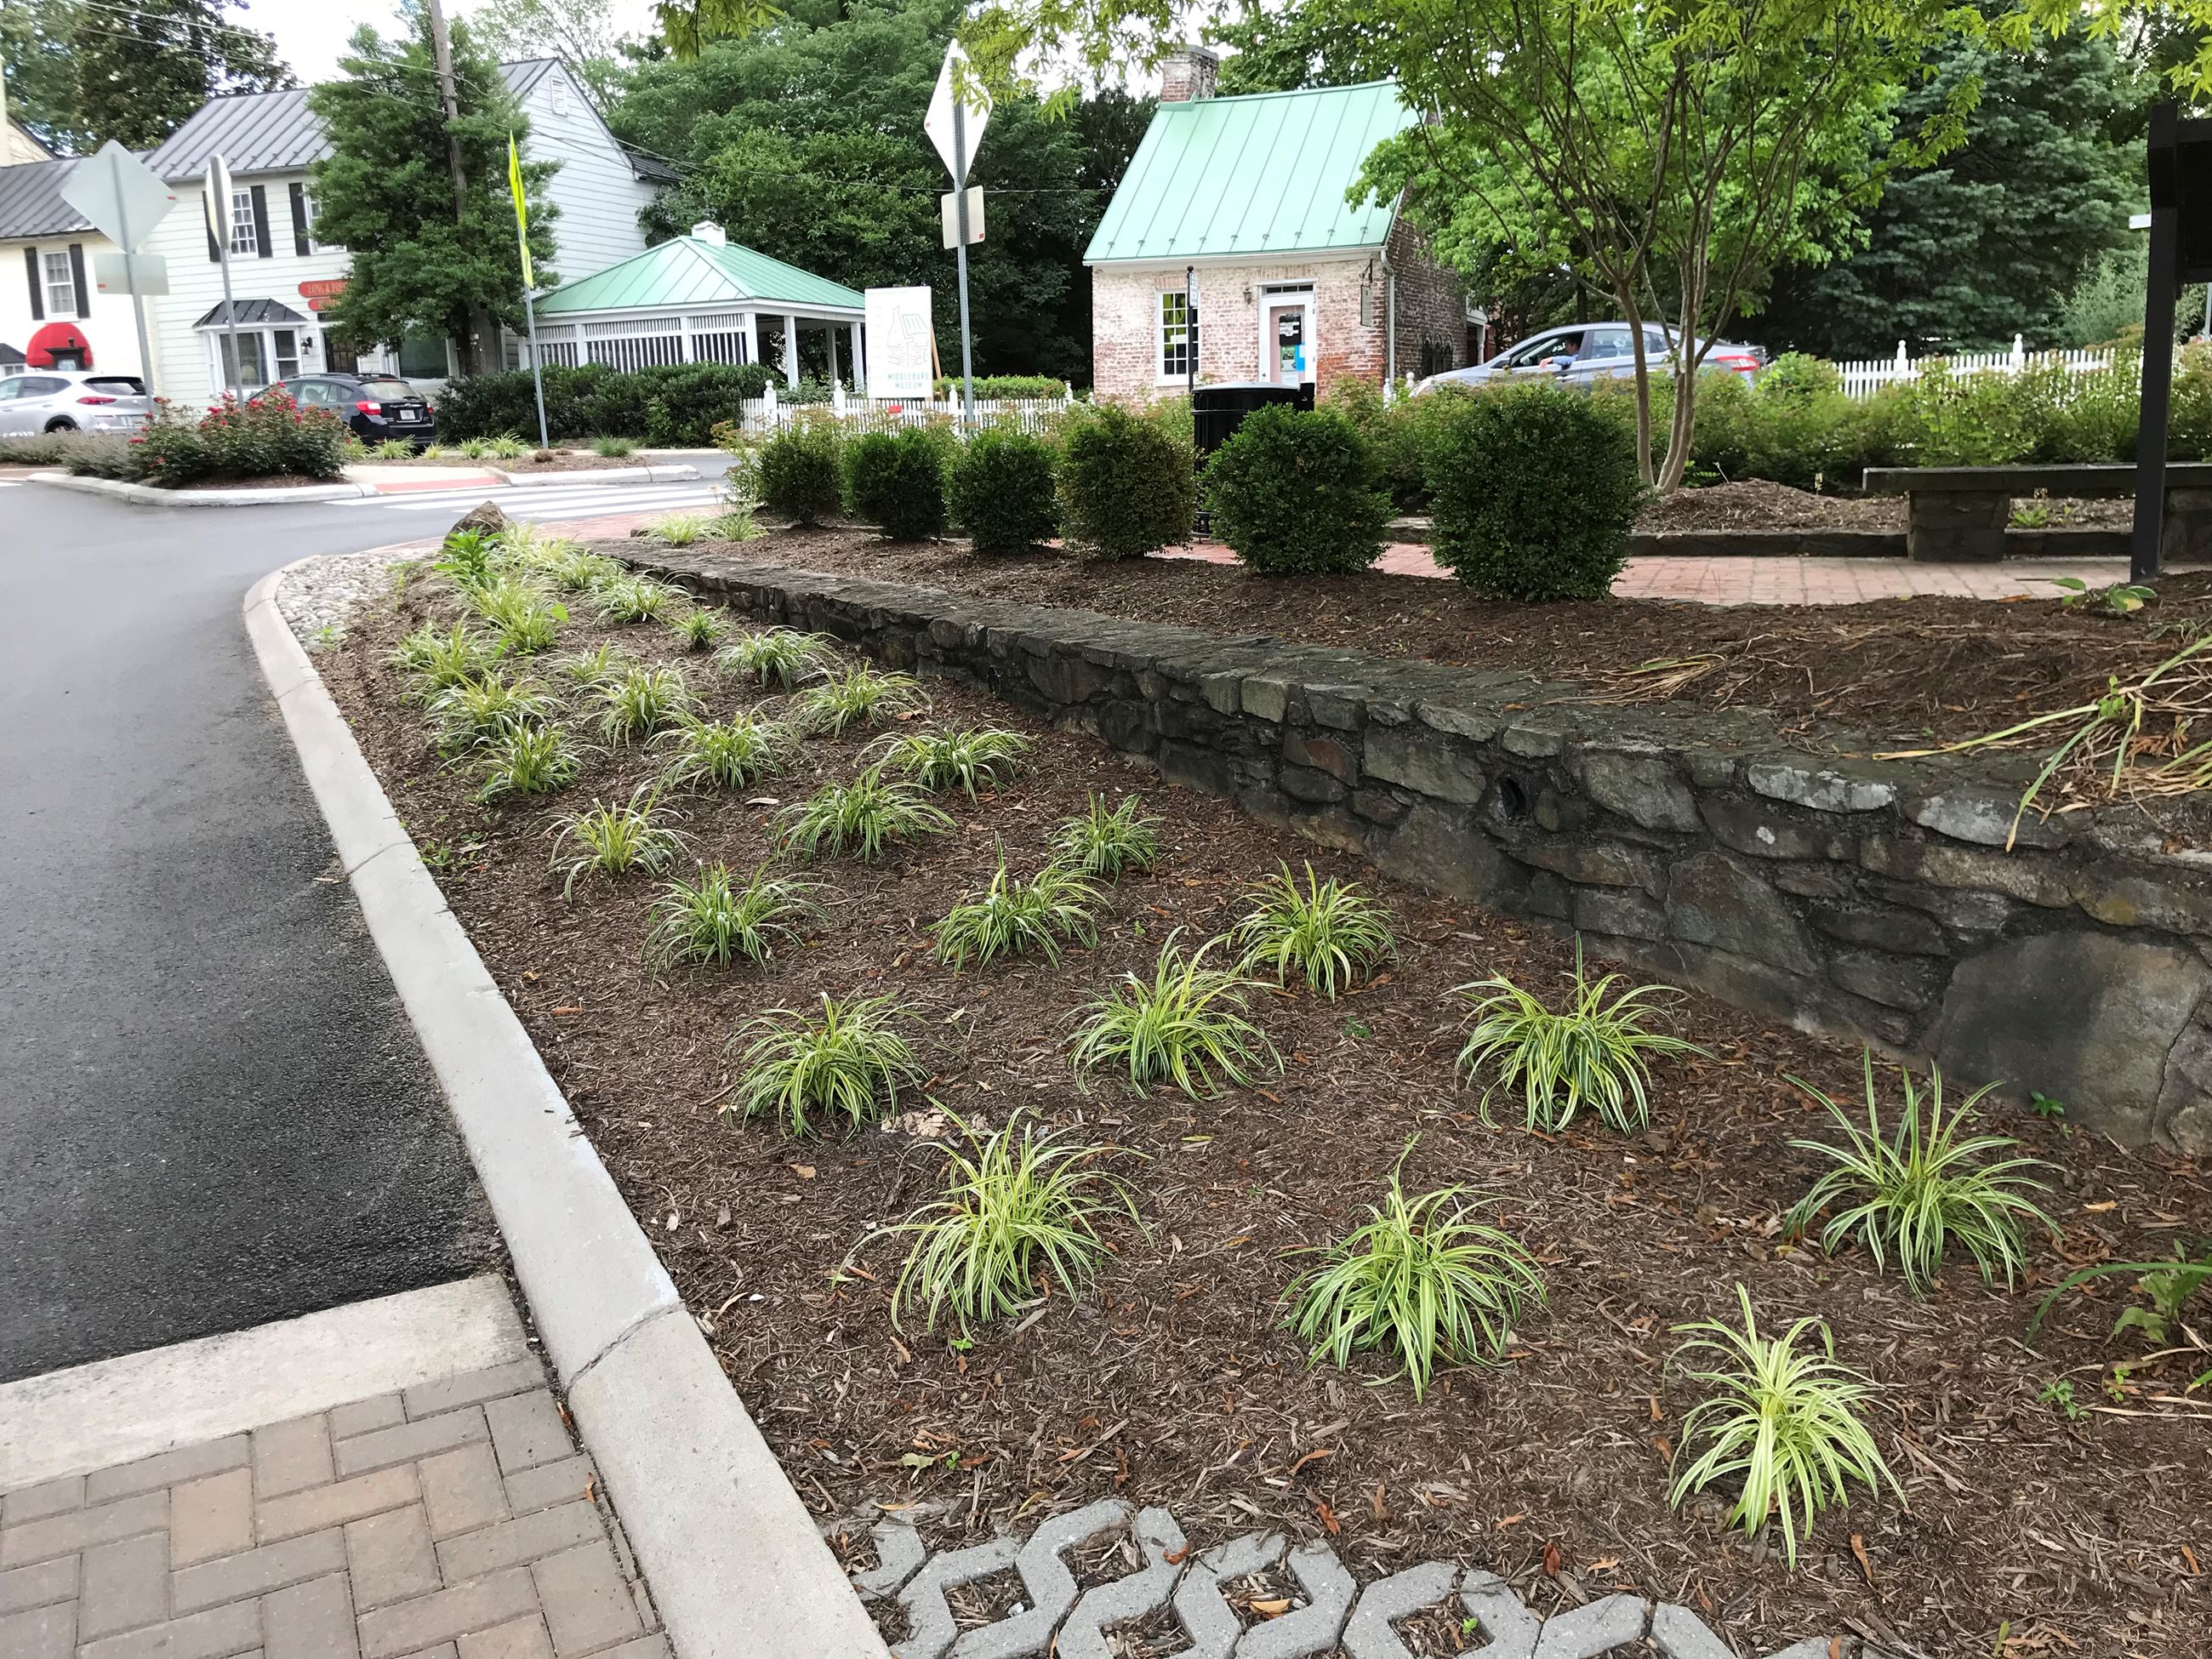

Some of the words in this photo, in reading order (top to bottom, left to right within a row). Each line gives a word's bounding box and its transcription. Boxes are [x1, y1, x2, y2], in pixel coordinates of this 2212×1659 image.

[308, 283, 325, 294] LONG
[887, 372, 929, 381] MIDDLEBURG
[895, 381, 922, 390] MUSEUM
